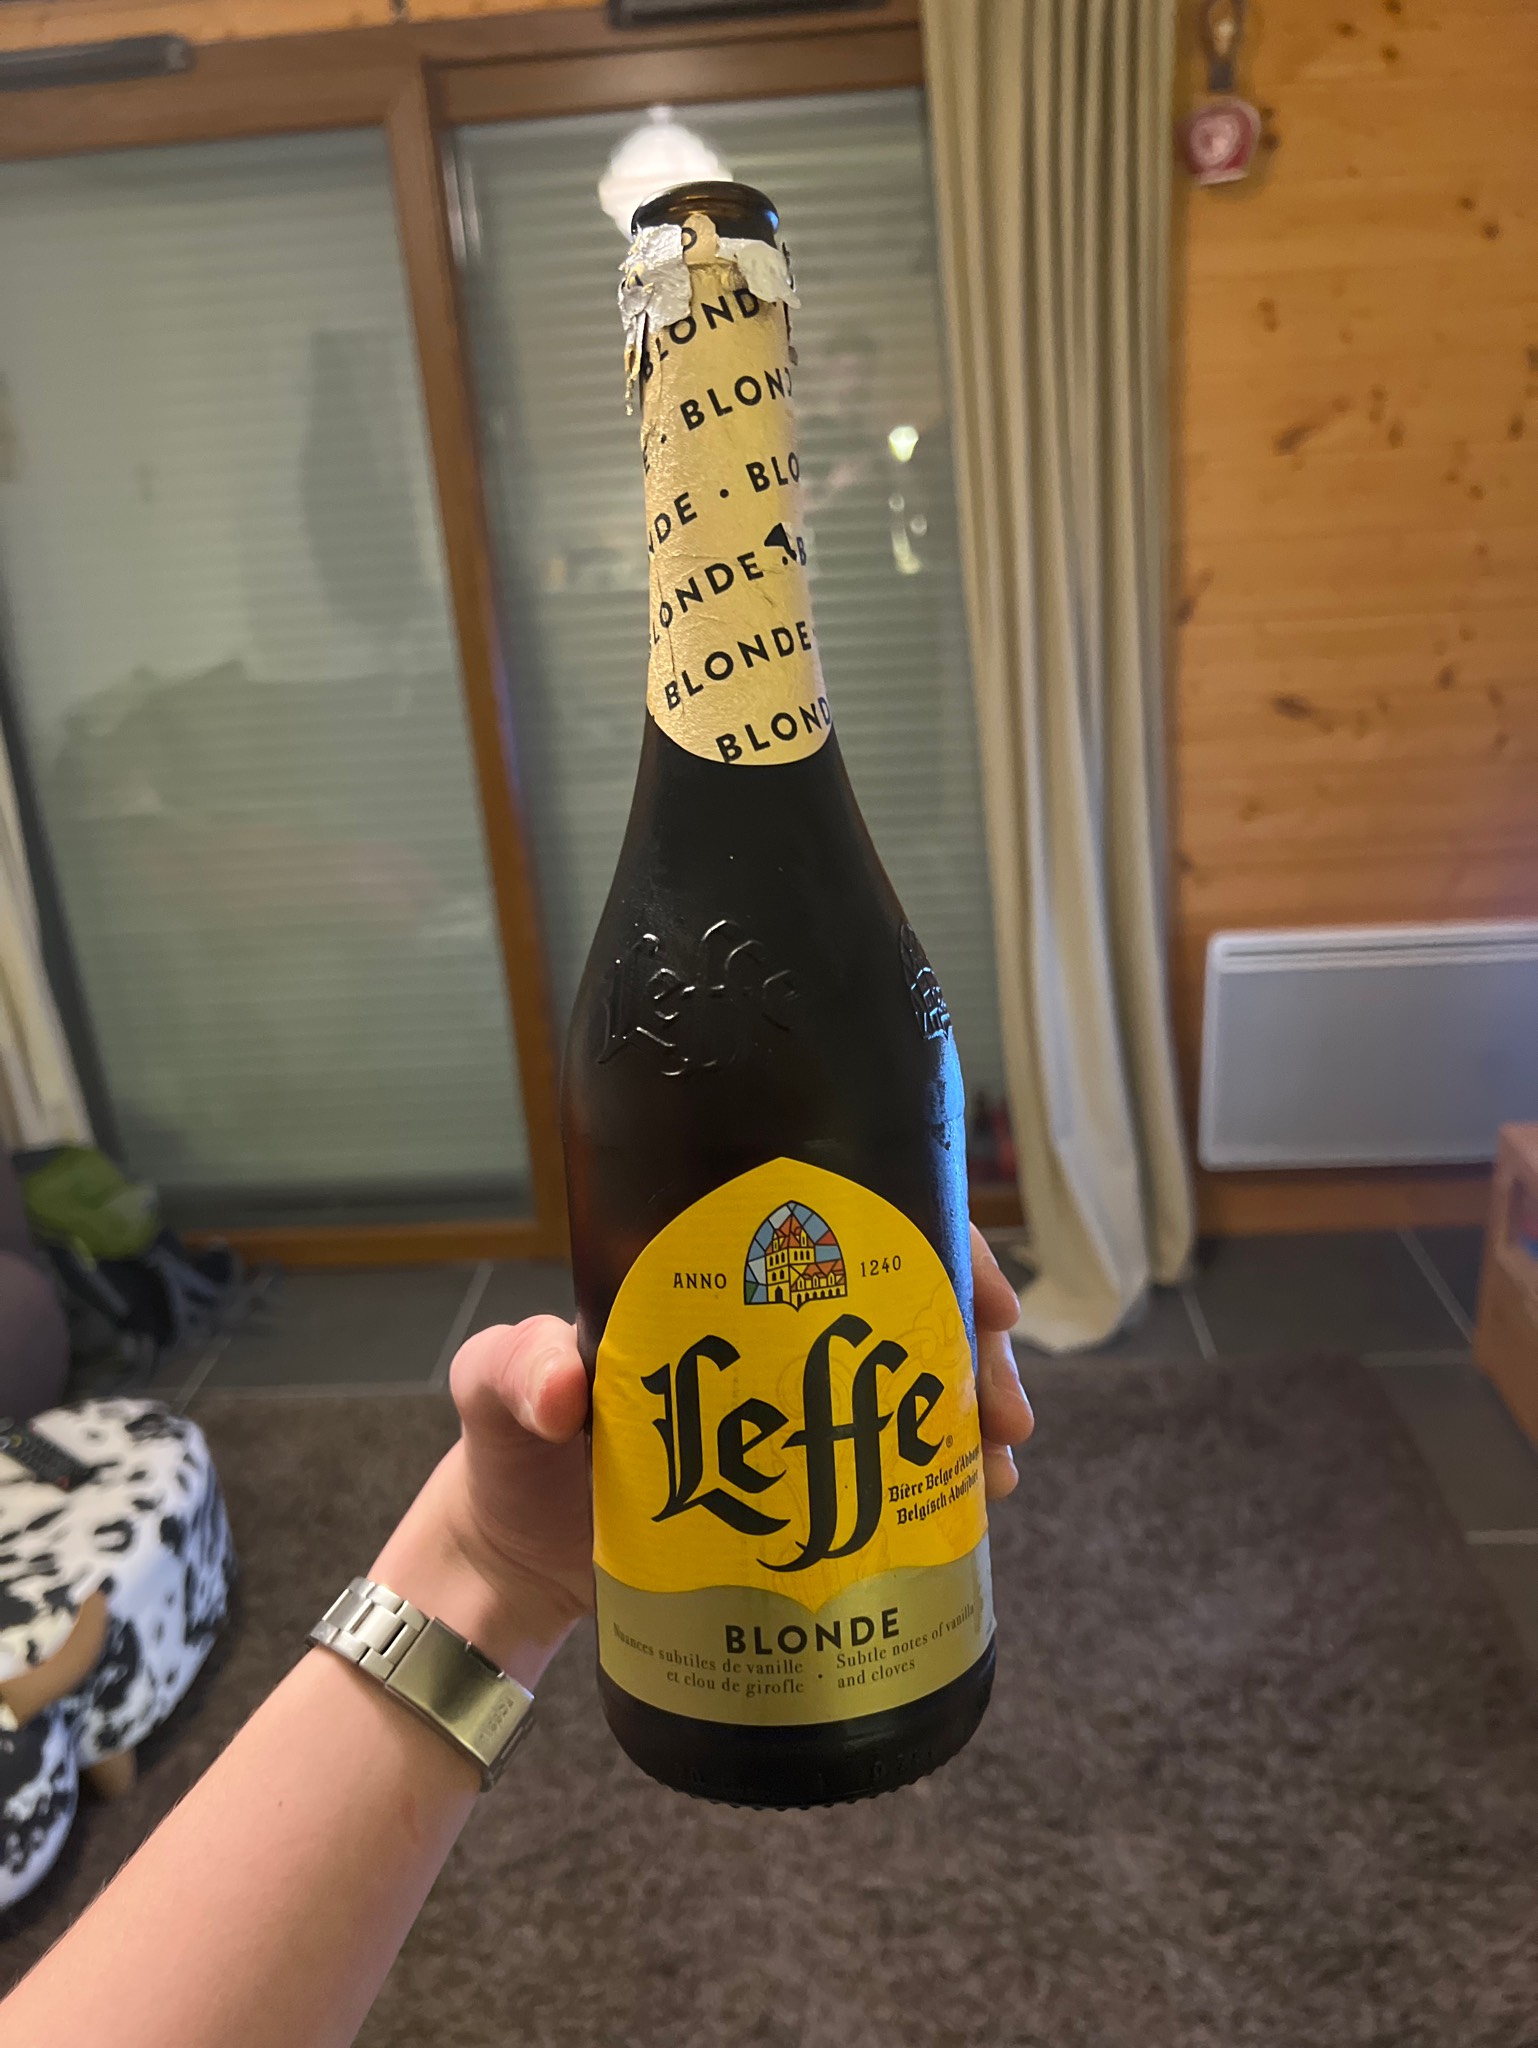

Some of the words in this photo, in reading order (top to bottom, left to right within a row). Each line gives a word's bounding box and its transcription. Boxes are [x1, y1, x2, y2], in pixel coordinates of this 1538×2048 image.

[644, 288, 761, 384] BLOND
[665, 621, 812, 711] BLONDE
[715, 697, 831, 764] BLOND
[673, 1272, 727, 1289] ANNO
[861, 1255, 902, 1277] 1240
[641, 1313, 945, 1572] Leffe
[888, 1483, 924, 1503] Bière
[925, 1467, 953, 1490] Belge
[897, 1492, 947, 1525] Belgisch
[613, 1622, 654, 1656] Nuances
[659, 1649, 716, 1671] subtiles
[722, 1658, 742, 1673] de
[746, 1659, 804, 1675] vanille
[725, 1607, 899, 1655] BLONDE
[836, 1646, 887, 1669] Subtle
[892, 1633, 928, 1654] notes
[931, 1621, 944, 1641] of
[945, 1603, 974, 1632] vanilla
[667, 1669, 679, 1683] et
[684, 1671, 715, 1690] clou
[721, 1677, 741, 1692] de
[745, 1679, 804, 1697] girofle
[838, 1669, 866, 1688] and
[871, 1658, 915, 1682] cloves
